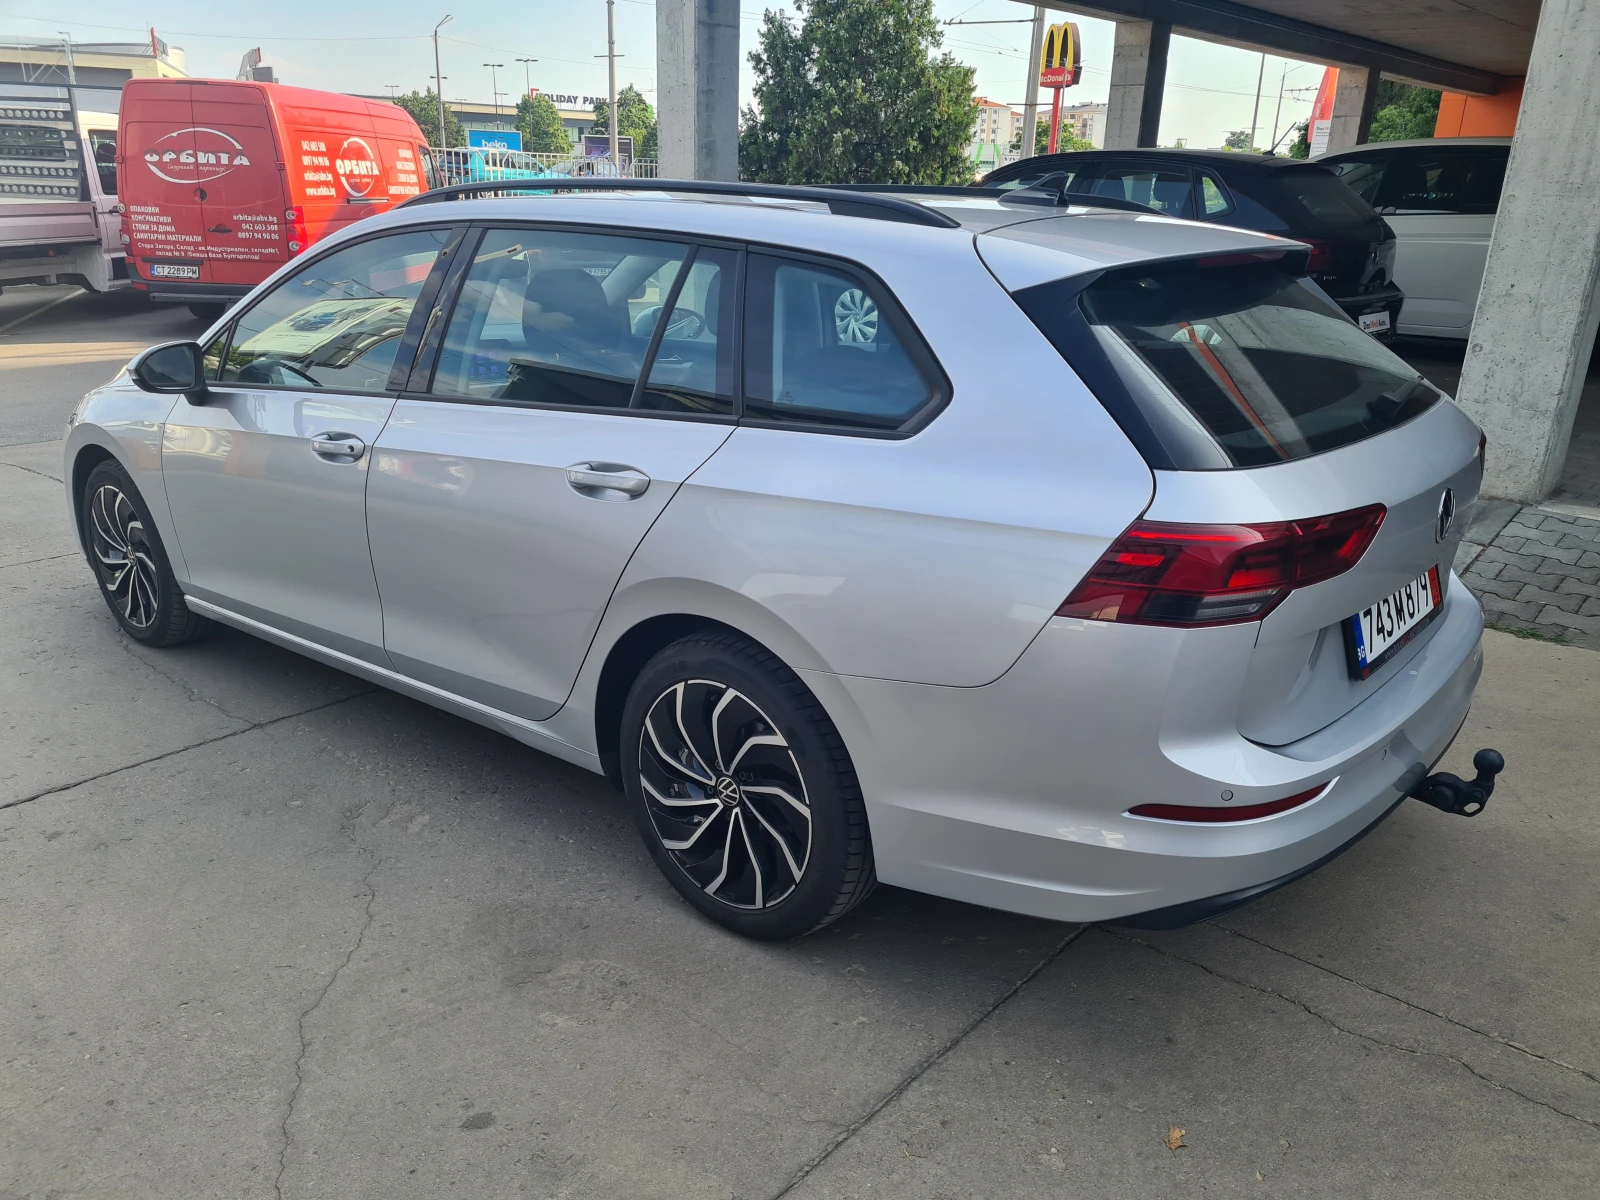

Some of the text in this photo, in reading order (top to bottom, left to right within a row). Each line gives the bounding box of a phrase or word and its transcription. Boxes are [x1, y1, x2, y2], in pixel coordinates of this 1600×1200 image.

[144, 148, 251, 166] ОРБИТА
[335, 158, 380, 176] ОРБИТА
[129, 205, 160, 213] ОПАКОВКИ
[131, 214, 172, 223] КОНСУМАТИВИ
[232, 213, 278, 223] orbita@abv.bg
[132, 223, 150, 231] СТОКИ
[241, 223, 253, 231] 042
[133, 232, 202, 243] САНИТАРНИ МАТЕРИАЛИ
[237, 231, 253, 239] 0897
[262, 232, 271, 240] 90
[155, 265, 198, 276] CT 2289 PM
